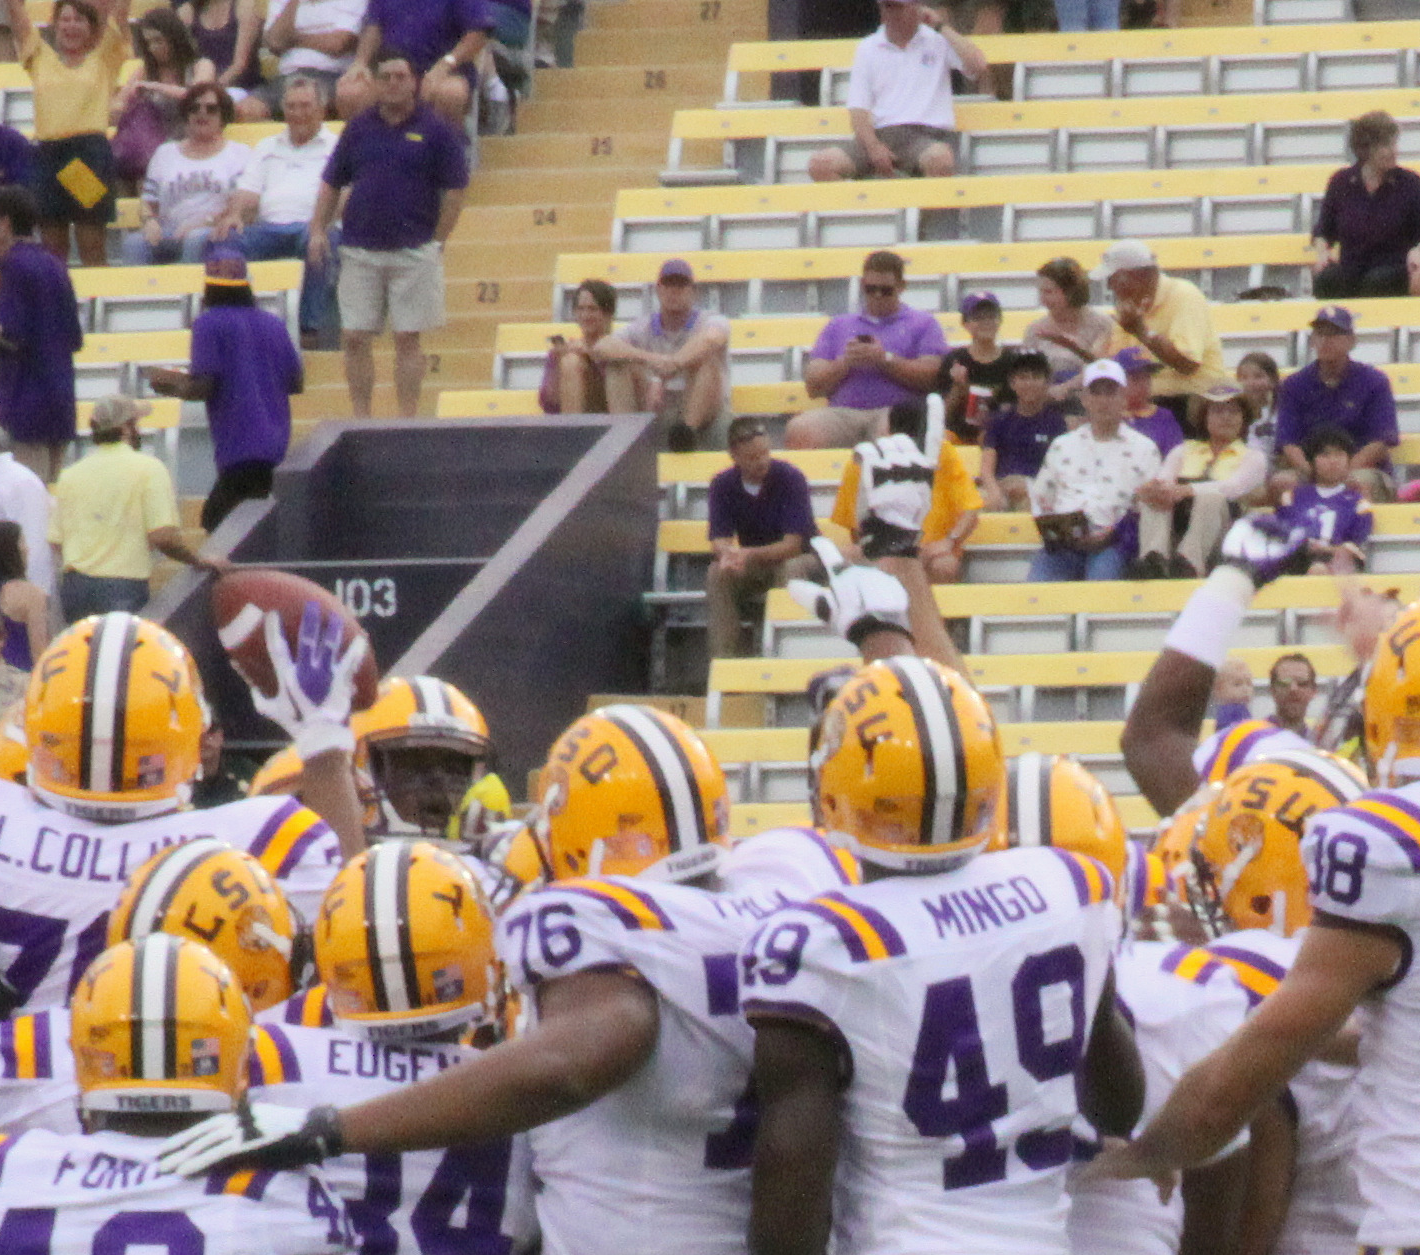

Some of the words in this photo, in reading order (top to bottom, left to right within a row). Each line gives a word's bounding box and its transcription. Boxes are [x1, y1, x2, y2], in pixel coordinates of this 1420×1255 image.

[643, 70, 666, 89] 26
[532, 208, 557, 227] 24
[476, 281, 500, 304] 23
[921, 876, 1047, 939] MINGO
[506, 903, 582, 978] 76
[328, 1041, 455, 1083] EUGE
[902, 943, 1091, 1192] 49
[114, 1095, 190, 1111] TIGERS
